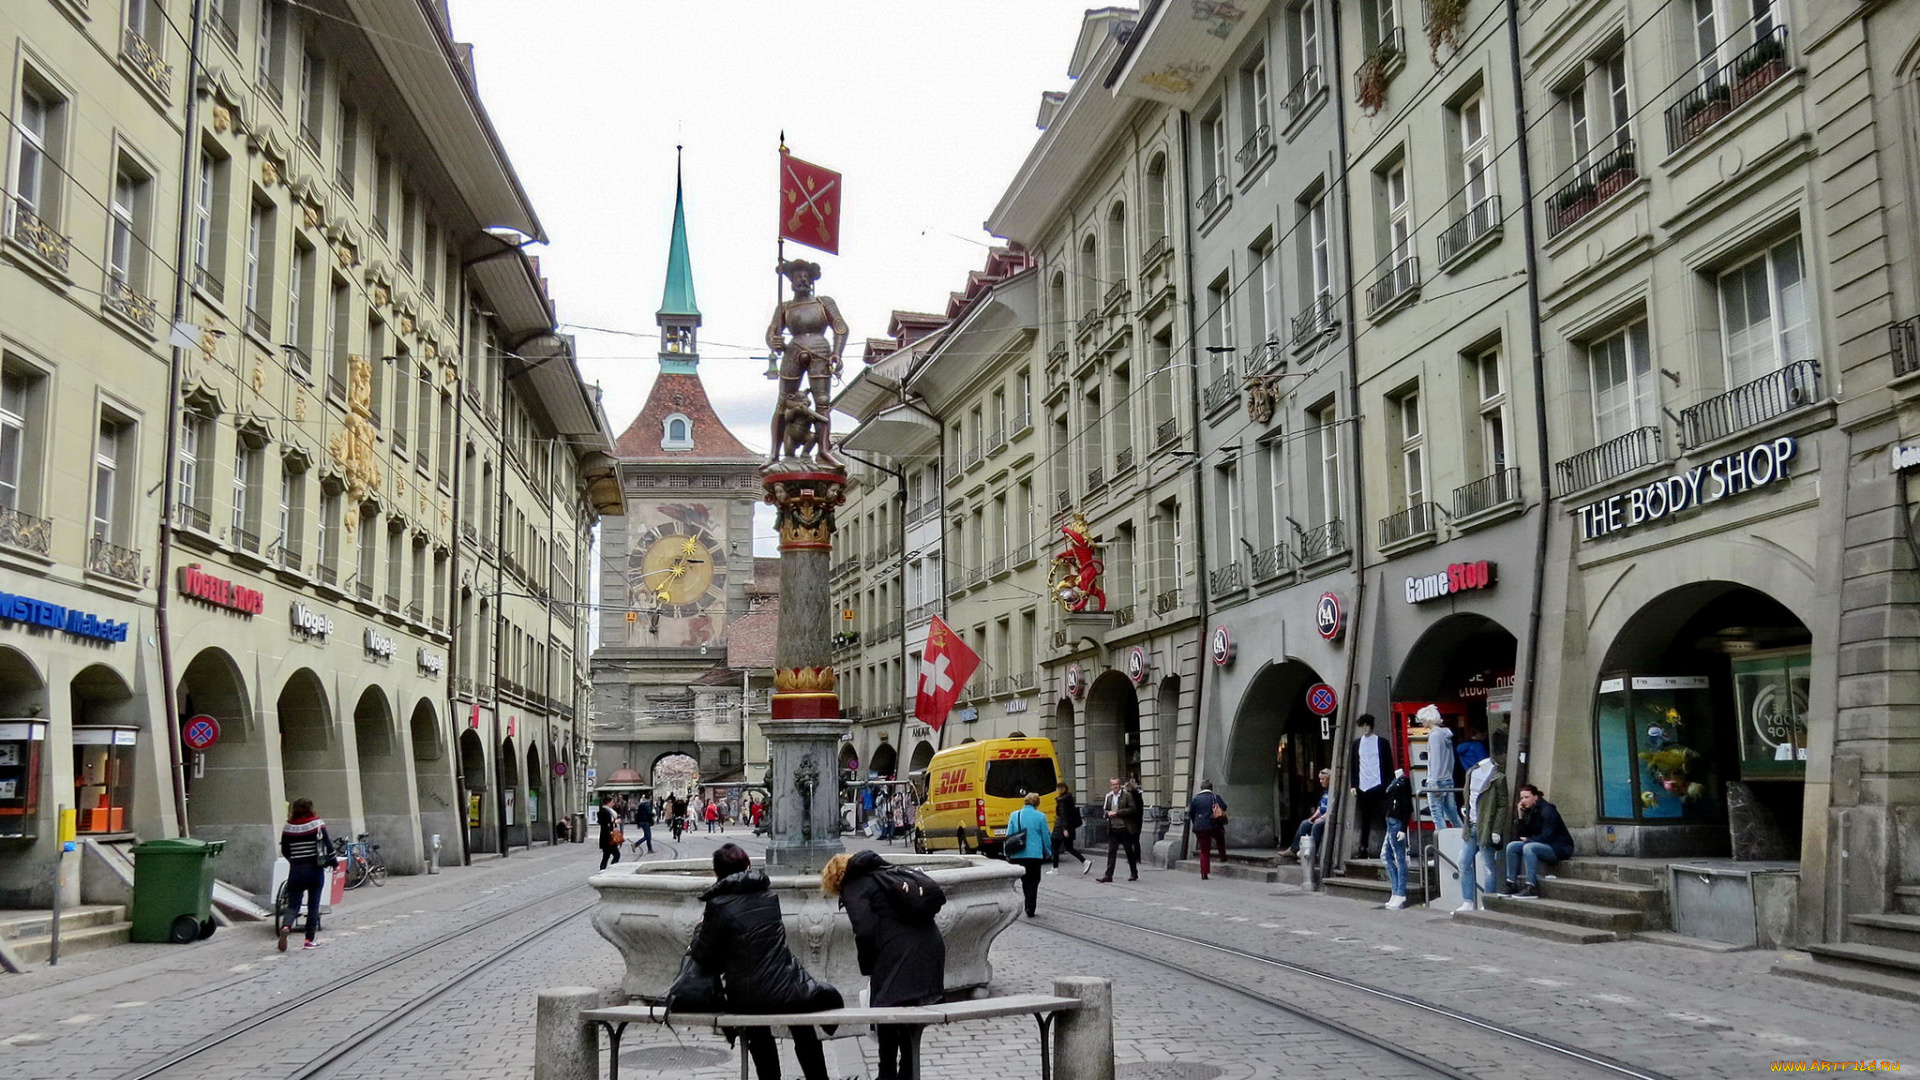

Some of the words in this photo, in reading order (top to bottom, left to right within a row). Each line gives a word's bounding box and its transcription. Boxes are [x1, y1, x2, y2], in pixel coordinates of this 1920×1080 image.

[1578, 495, 1622, 539] THE
[1630, 466, 1703, 524] BODY
[1710, 437, 1794, 498] SHOP
[184, 563, 231, 605] VÖGELE
[233, 584, 264, 614] SHOES
[1405, 561, 1489, 604] GameStop
[298, 604, 334, 635] Vögele
[370, 629, 398, 656] Vögele
[998, 748, 1041, 759] DHL
[939, 768, 967, 795] DHL
